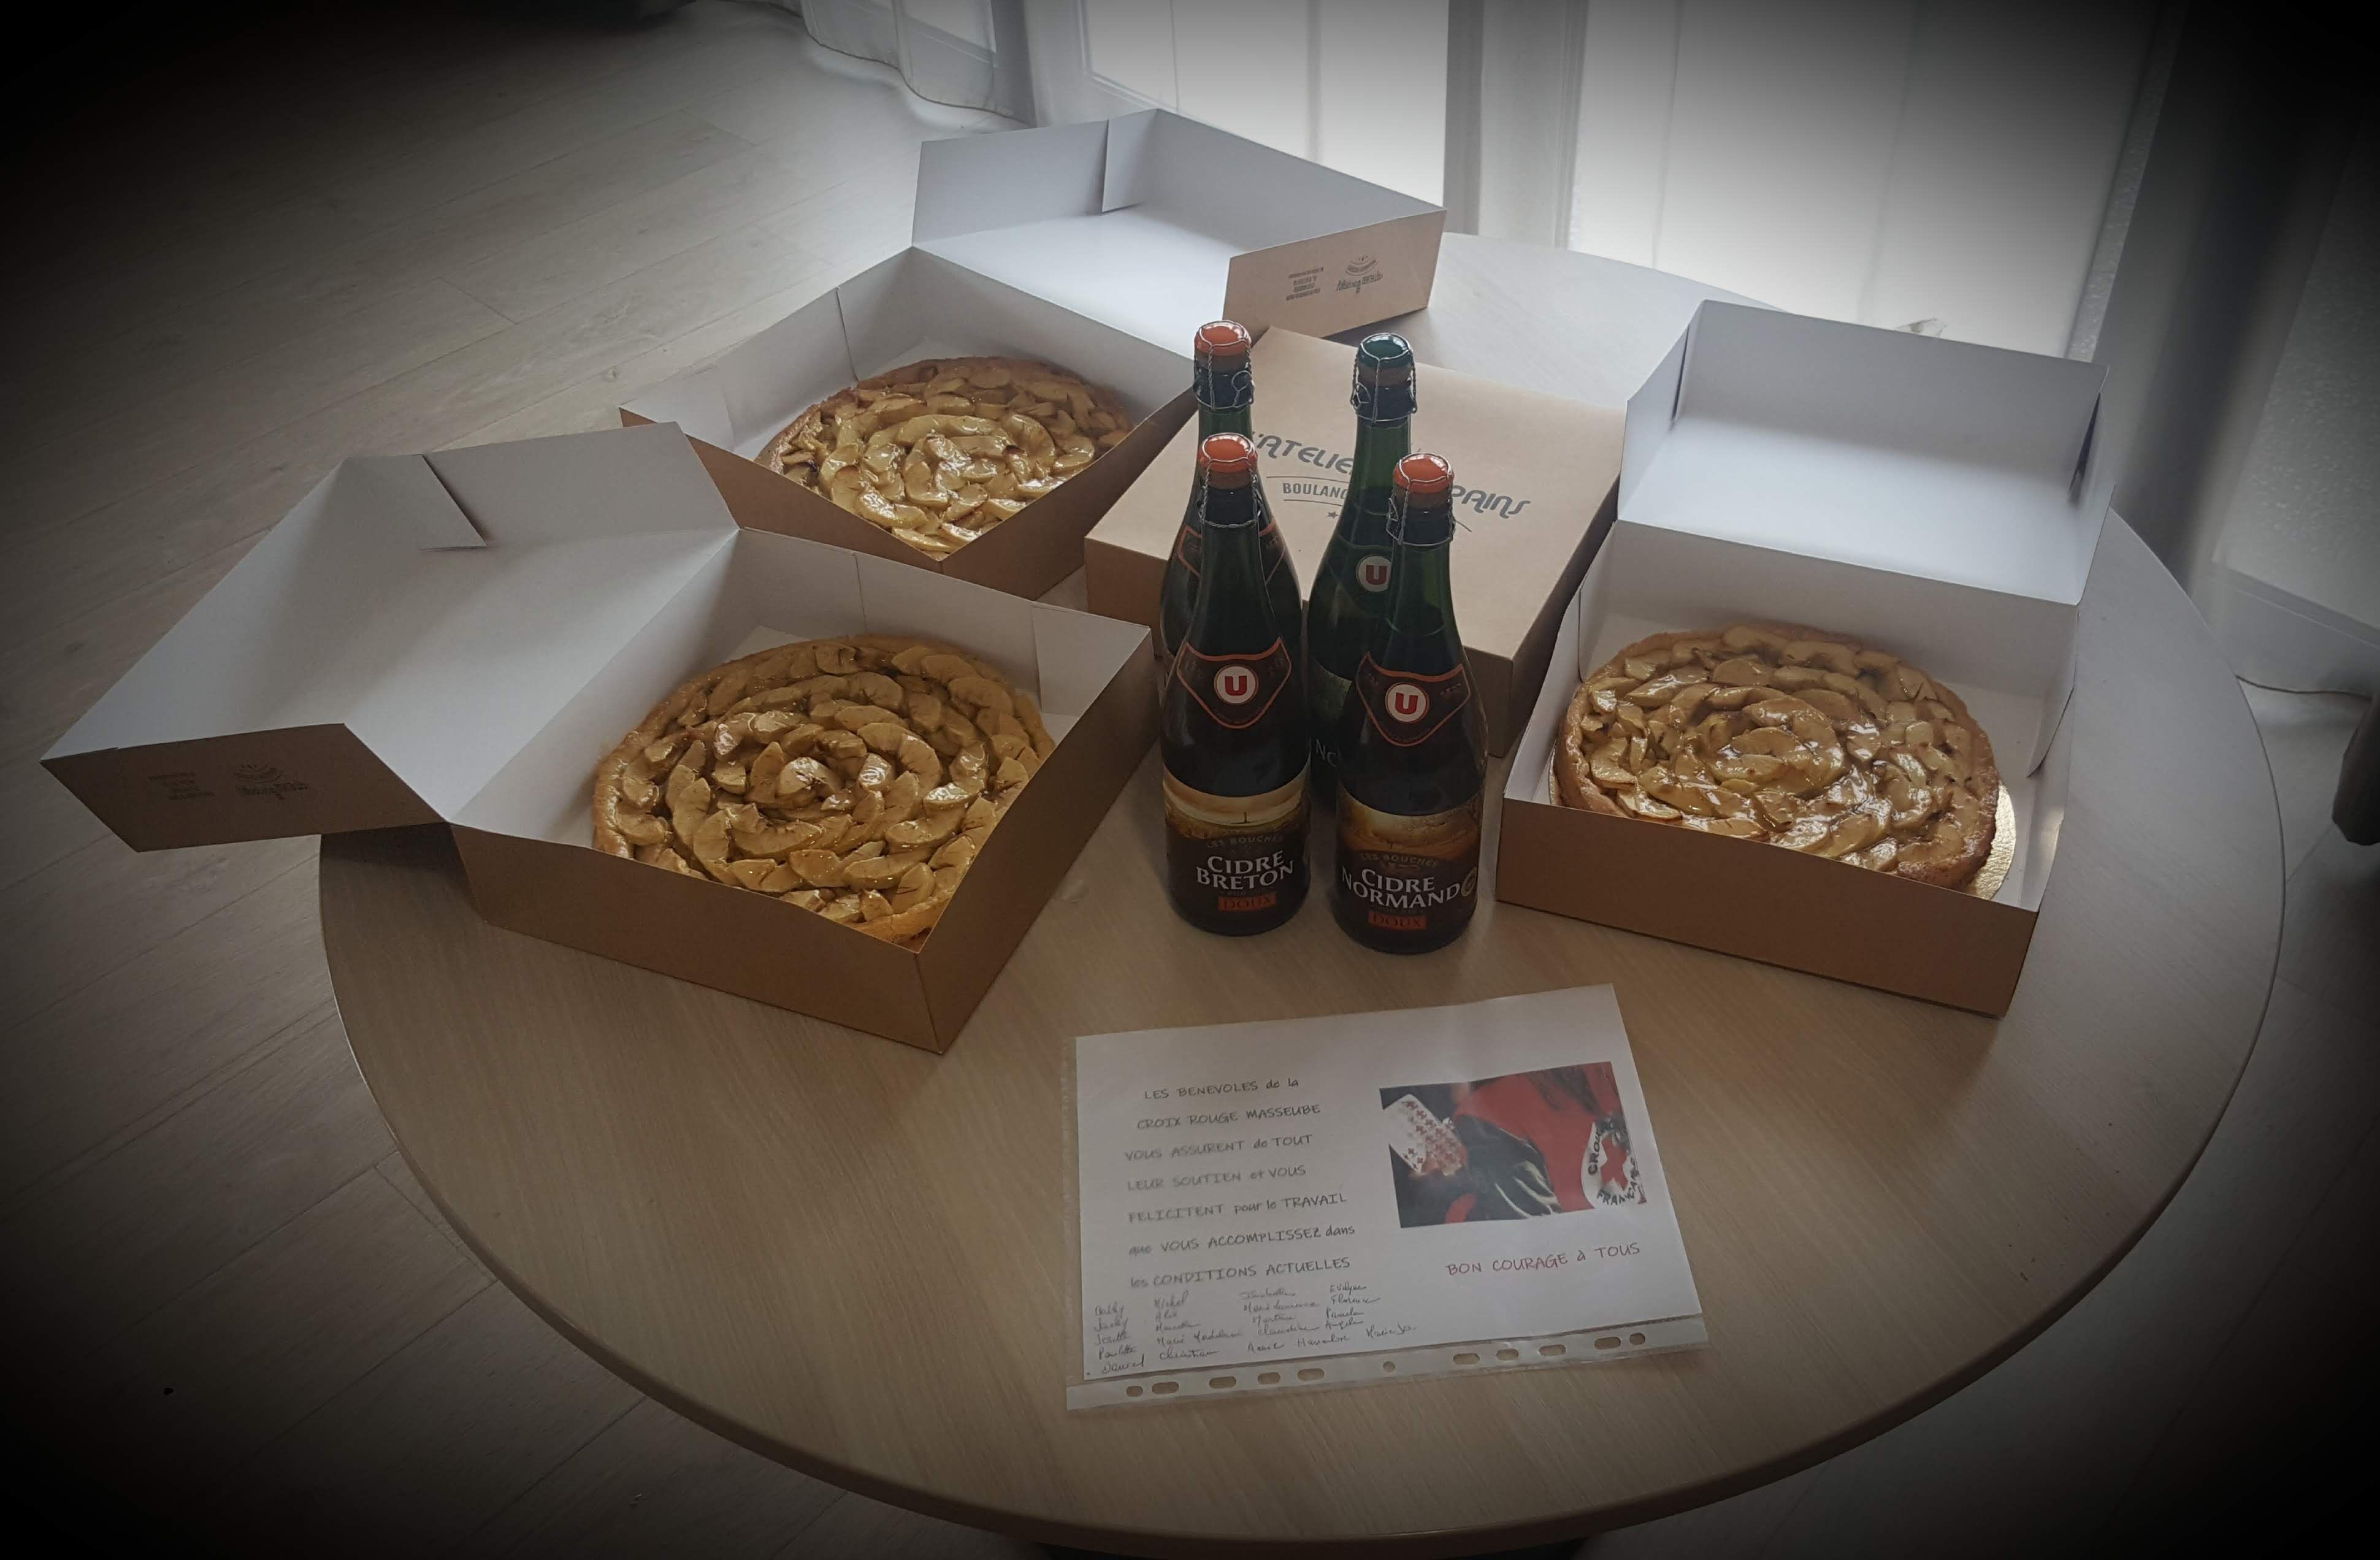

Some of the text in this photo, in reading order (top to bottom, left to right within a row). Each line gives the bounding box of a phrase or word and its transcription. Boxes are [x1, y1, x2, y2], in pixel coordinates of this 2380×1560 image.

[1366, 564, 1387, 585] U
[1225, 675, 1247, 696] U
[1395, 692, 1418, 714] U
[1195, 860, 1293, 890] BRETON
[1207, 850, 1285, 874] CIDRE
[1342, 865, 1461, 909] NORMAND
[1361, 868, 1436, 893] CIDRE
[1223, 896, 1272, 909] DOUX
[1372, 913, 1423, 928] DOUX
[1145, 1078, 1299, 1099] LES BENEVOLES de la
[1137, 1104, 1321, 1130] CROIX ROUGE MASSEUBE
[1124, 1134, 1313, 1162] VOUS ASSURENT de TOUT
[1127, 1165, 1306, 1191] LEUR SOUTIEN et VOUS
[1128, 1193, 1348, 1223] FELICITENT pour le TRAVAIL
[1128, 1225, 1356, 1256] que VOUS ACCOMPLISSEZ dans
[1445, 1261, 1482, 1276] BON
[1492, 1253, 1568, 1272] COURAGE
[1594, 1242, 1640, 1259] TOUS
[1130, 1257, 1350, 1288] les CONDITIONS ACTUELLES
